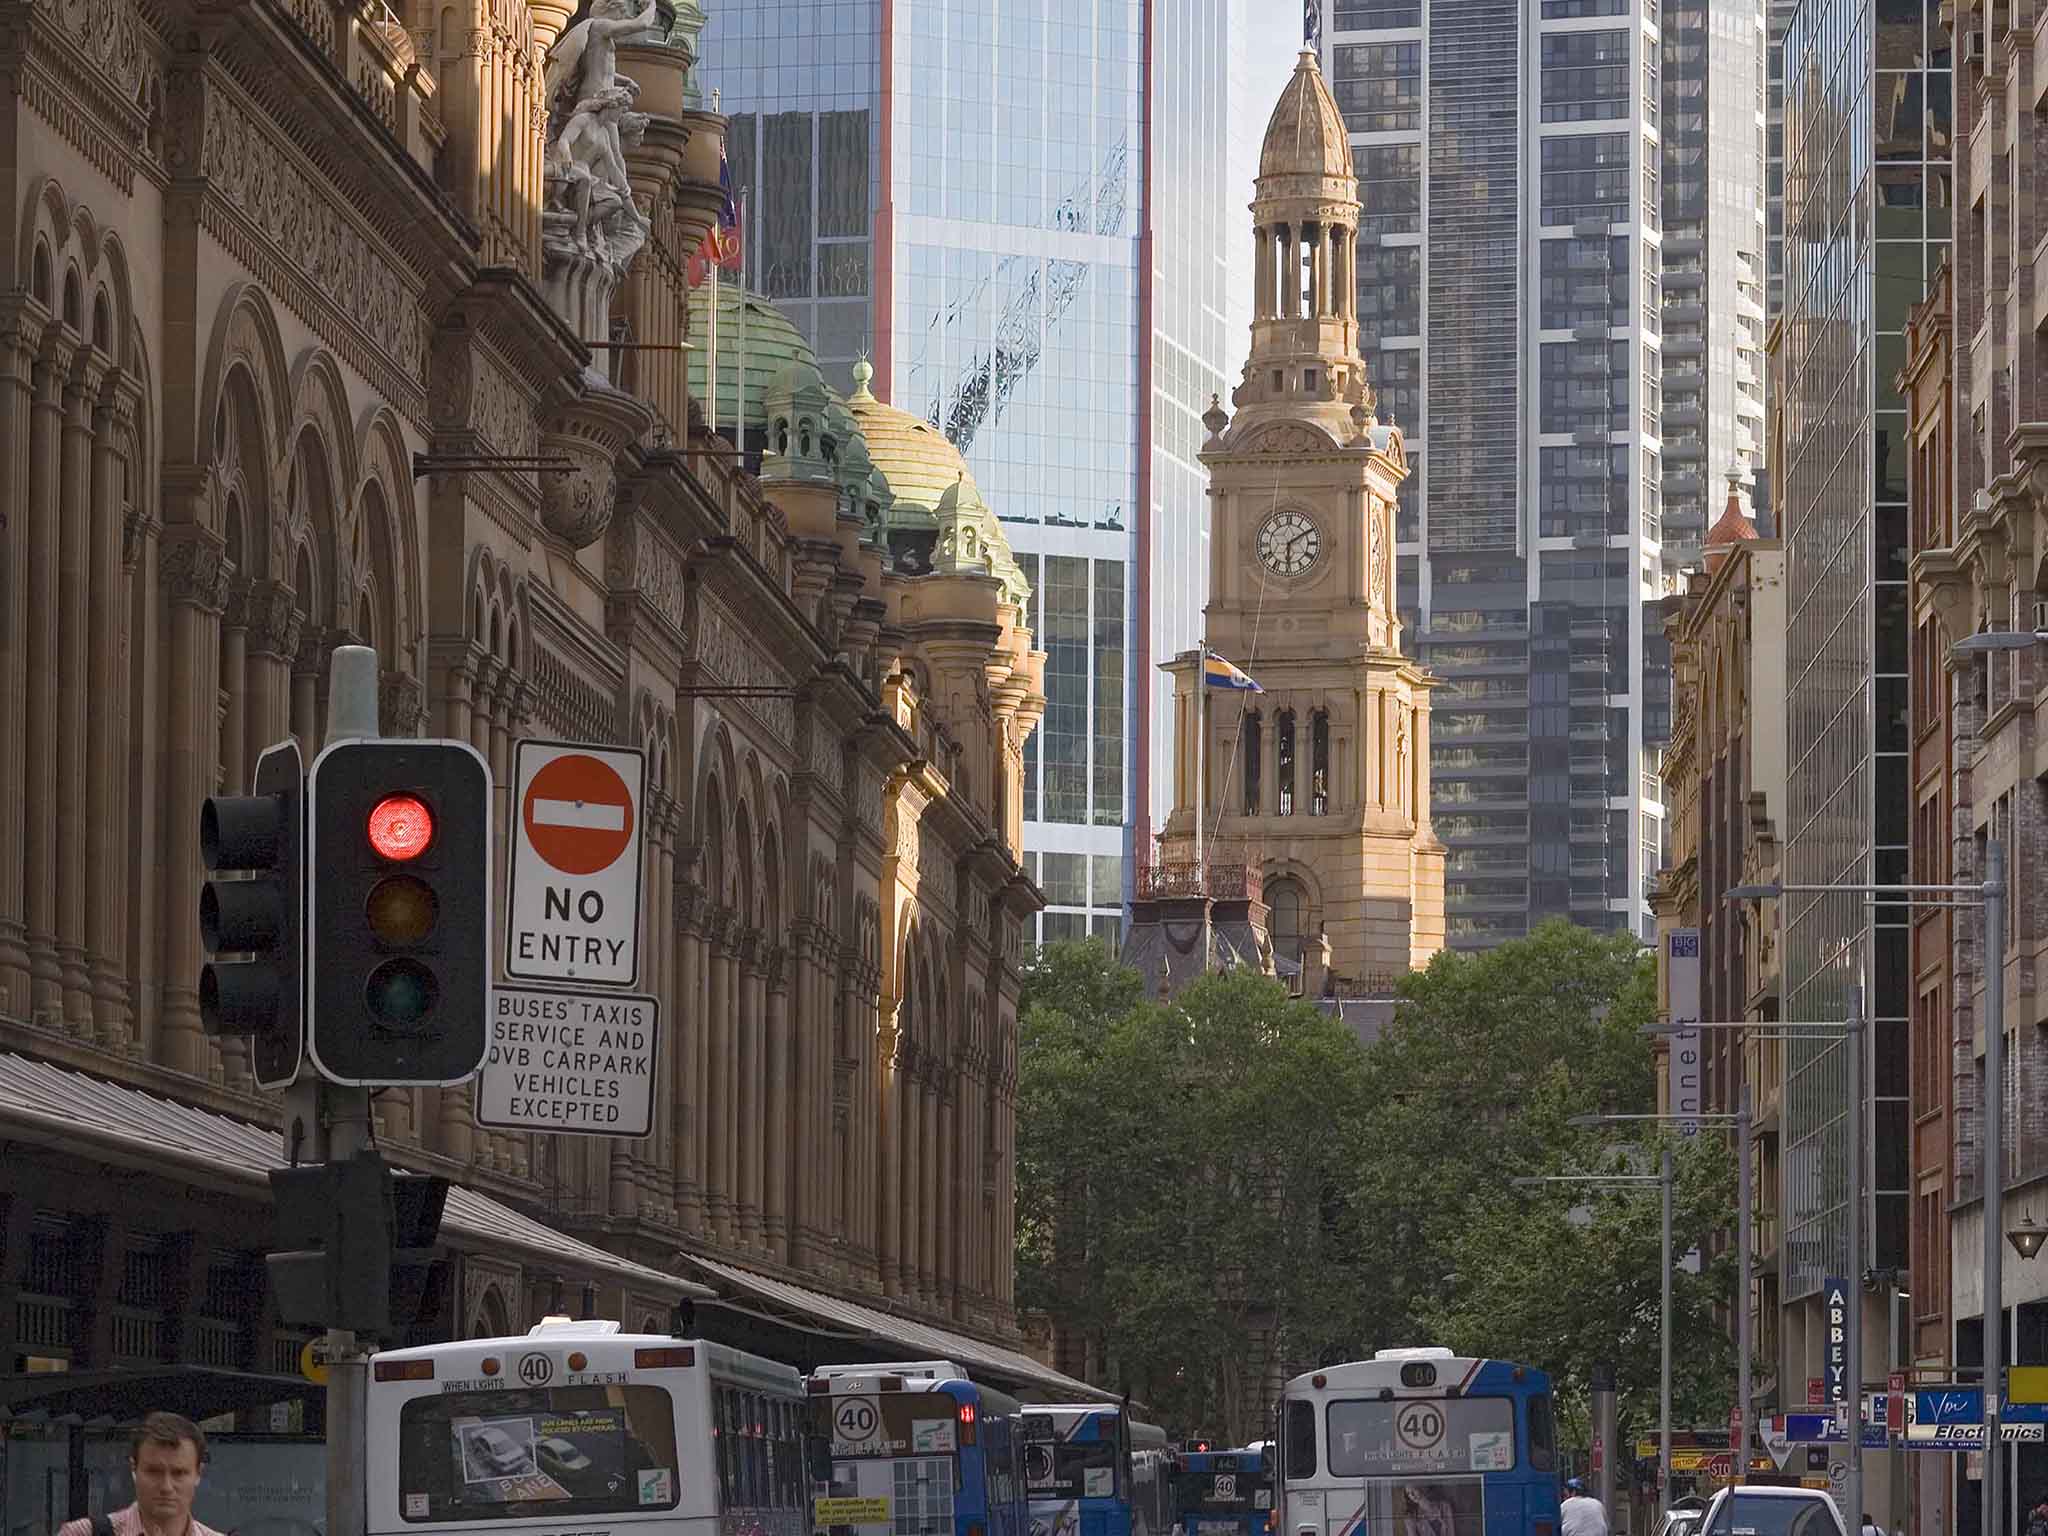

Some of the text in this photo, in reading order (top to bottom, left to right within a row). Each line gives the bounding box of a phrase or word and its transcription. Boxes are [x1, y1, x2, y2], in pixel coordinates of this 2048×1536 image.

[544, 886, 604, 924] NO
[519, 932, 626, 966] ENTRY
[498, 997, 643, 1026] BUSES TAXIS
[494, 1021, 645, 1051] SERVICE AND
[543, 1048, 648, 1075] CARPARK
[514, 1073, 620, 1098] VEHICLES
[510, 1098, 619, 1122] EXCEPTED
[523, 1358, 548, 1380] 40
[442, 1373, 627, 1393] WHEN LIGHTS FLASH
[839, 1408, 874, 1431] 40
[1403, 1413, 1439, 1437] 40
[1934, 1425, 2042, 1441] Electnics
[1711, 1464, 1730, 1477] STO
